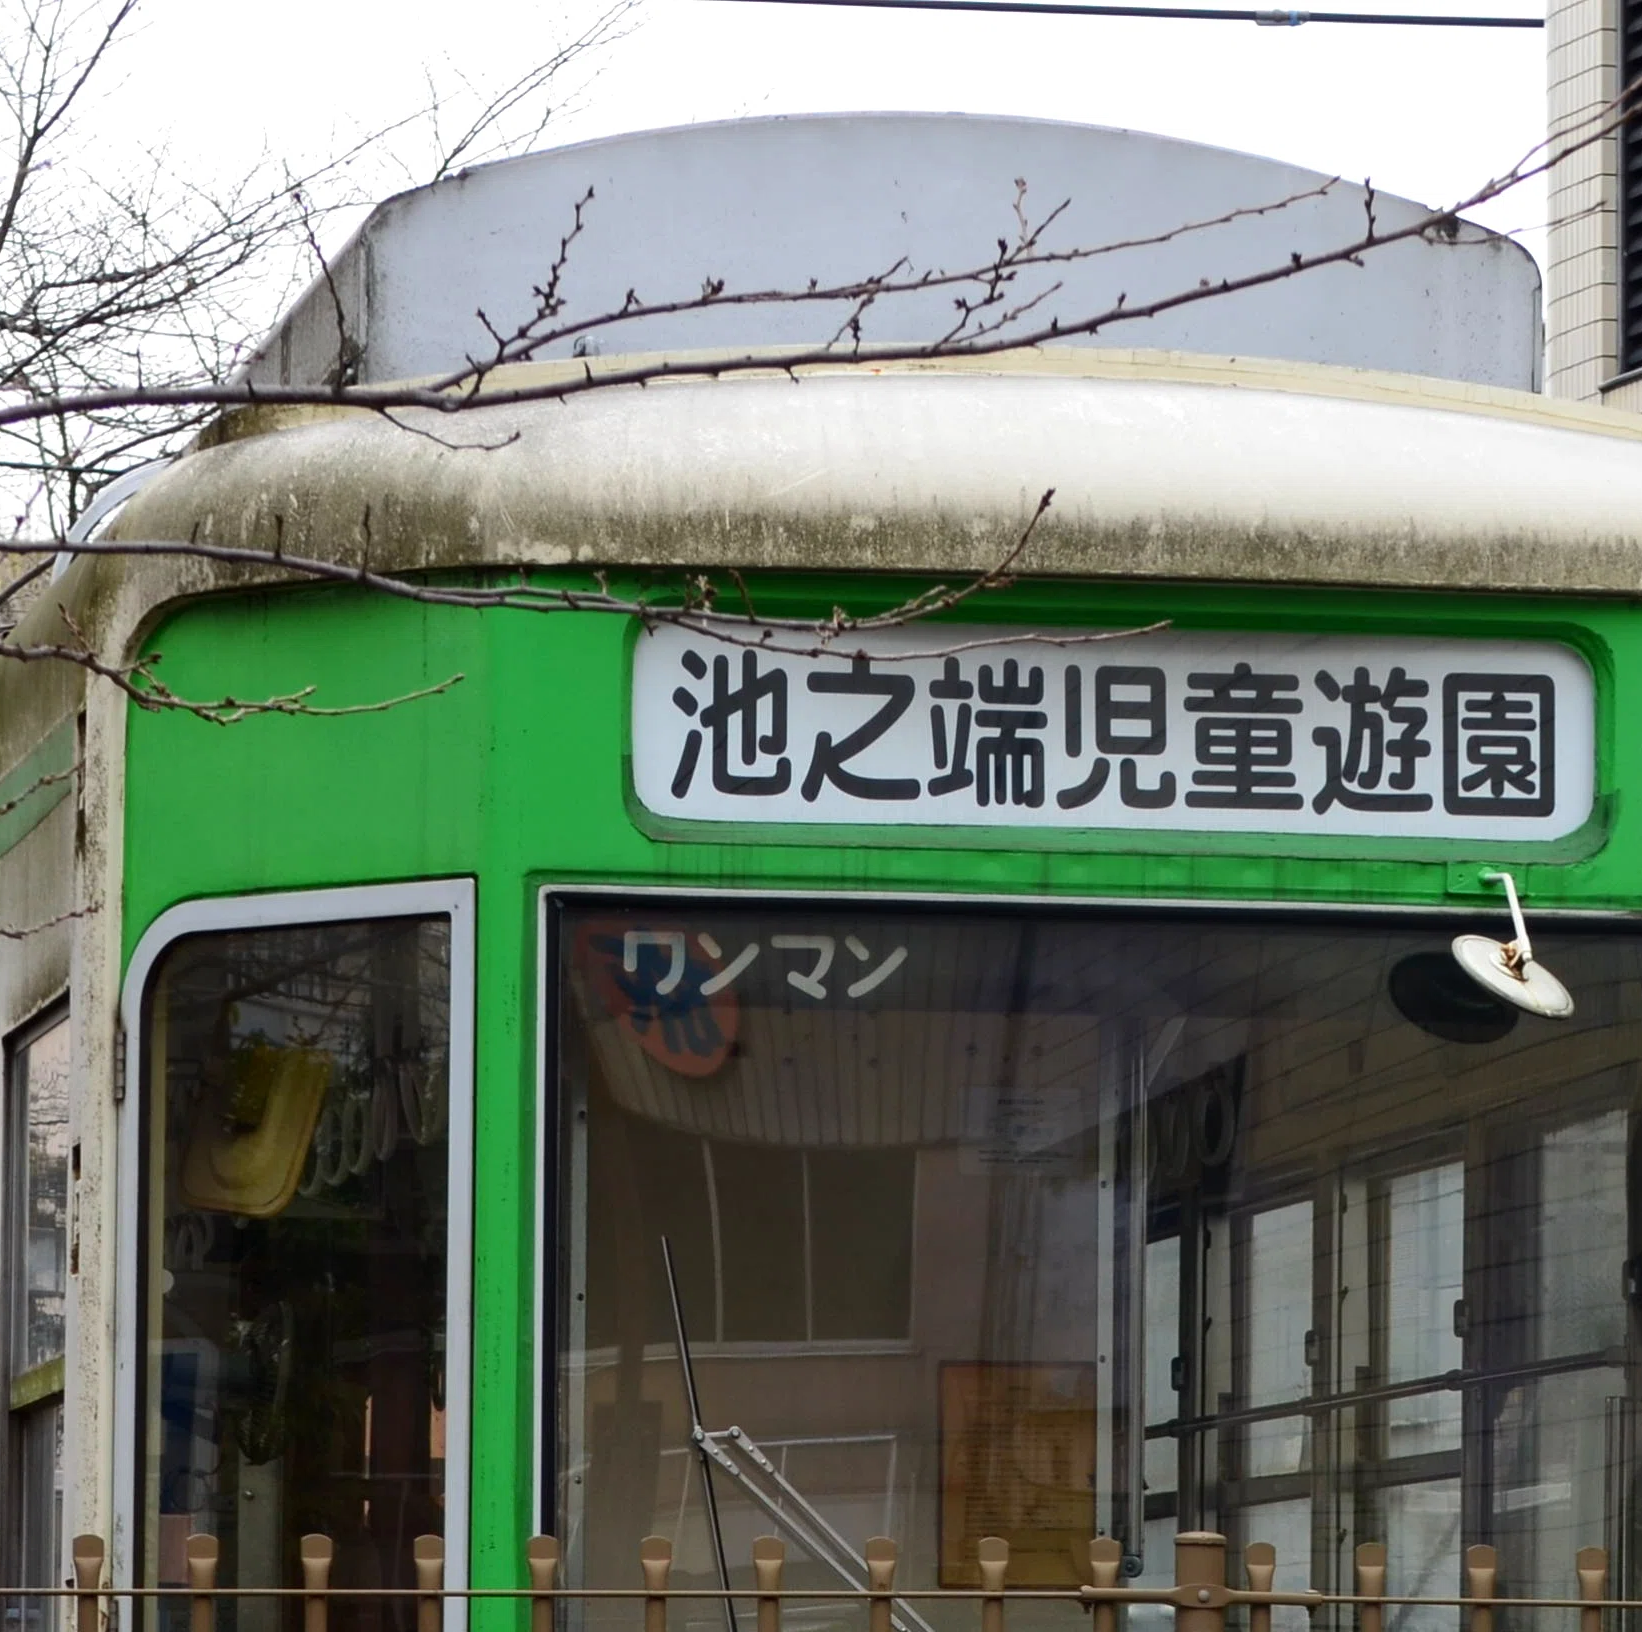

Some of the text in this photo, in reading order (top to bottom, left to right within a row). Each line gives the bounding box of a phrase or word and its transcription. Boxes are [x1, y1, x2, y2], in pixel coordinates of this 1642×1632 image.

[671, 649, 1556, 818] 池之端児童遊園
[624, 930, 909, 1000] ワンマン
